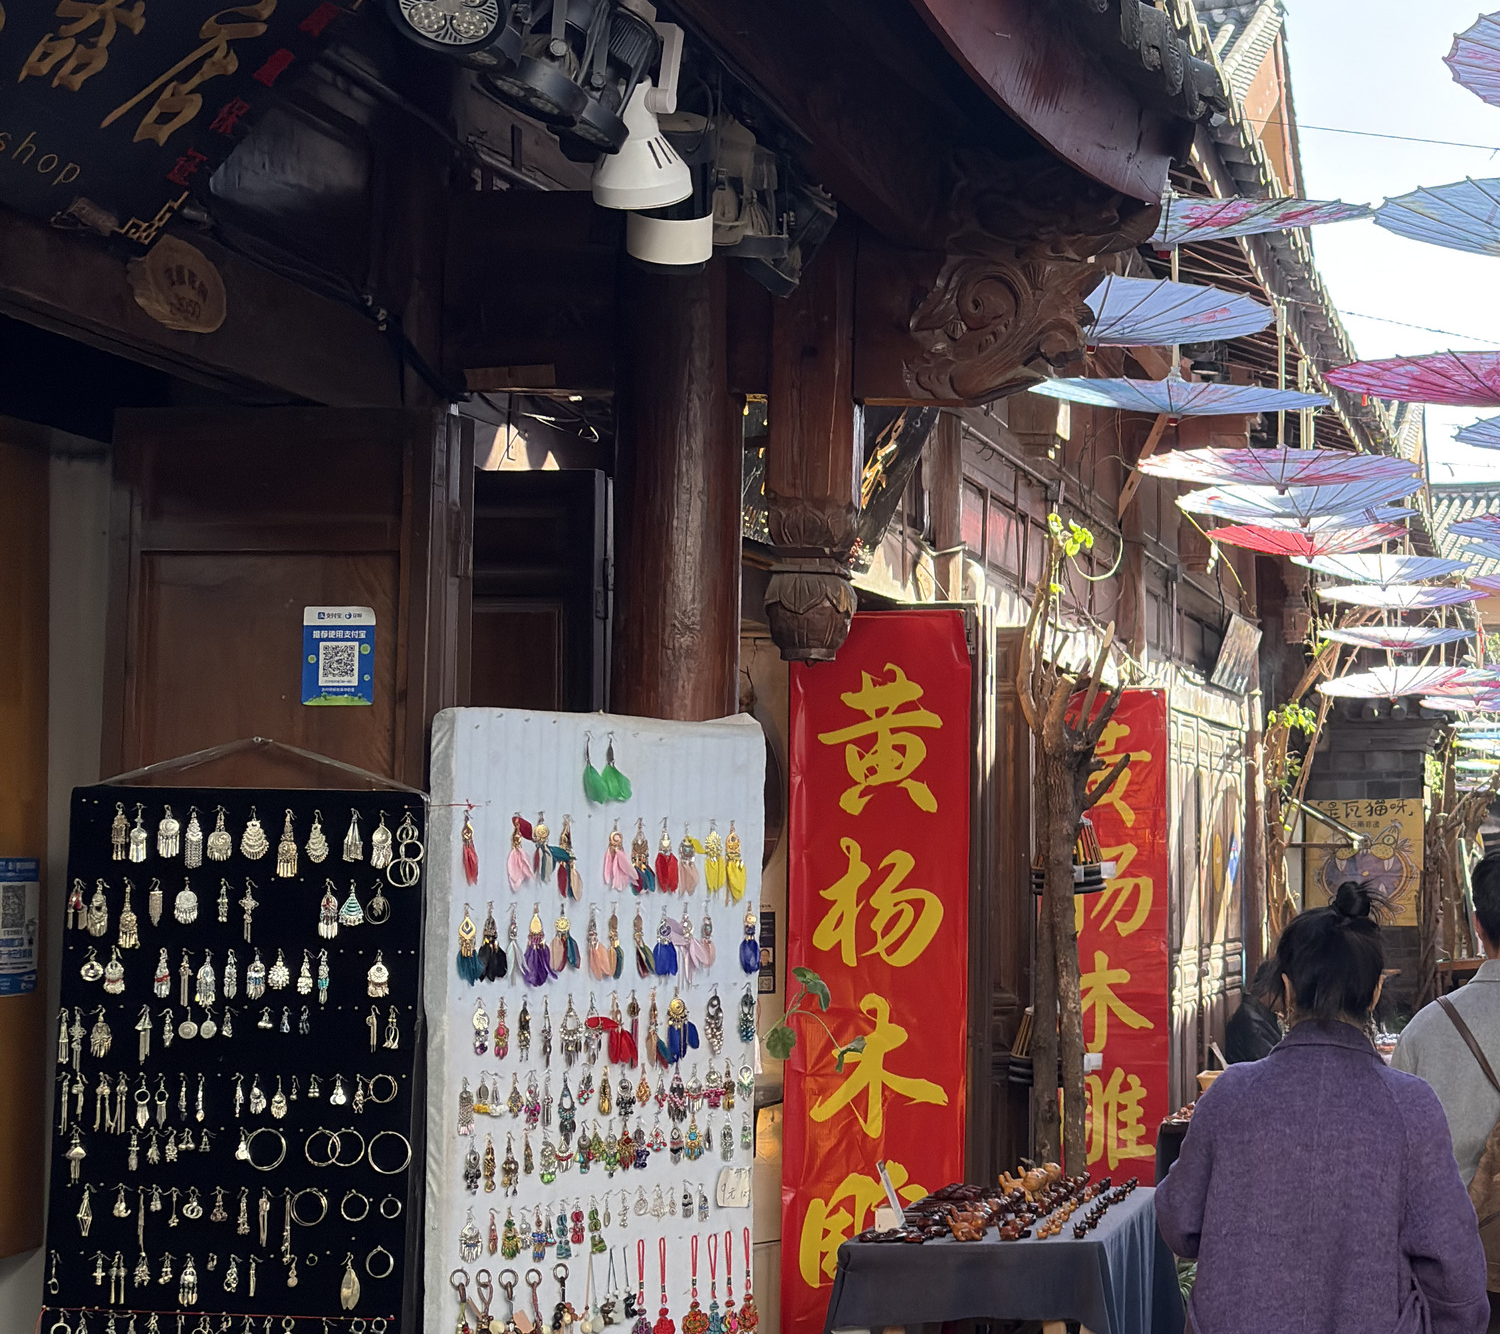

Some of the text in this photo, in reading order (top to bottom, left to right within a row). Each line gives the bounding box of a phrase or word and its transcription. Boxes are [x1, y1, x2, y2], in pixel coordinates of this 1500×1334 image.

[312, 629, 367, 639] 推荐使用支付宝
